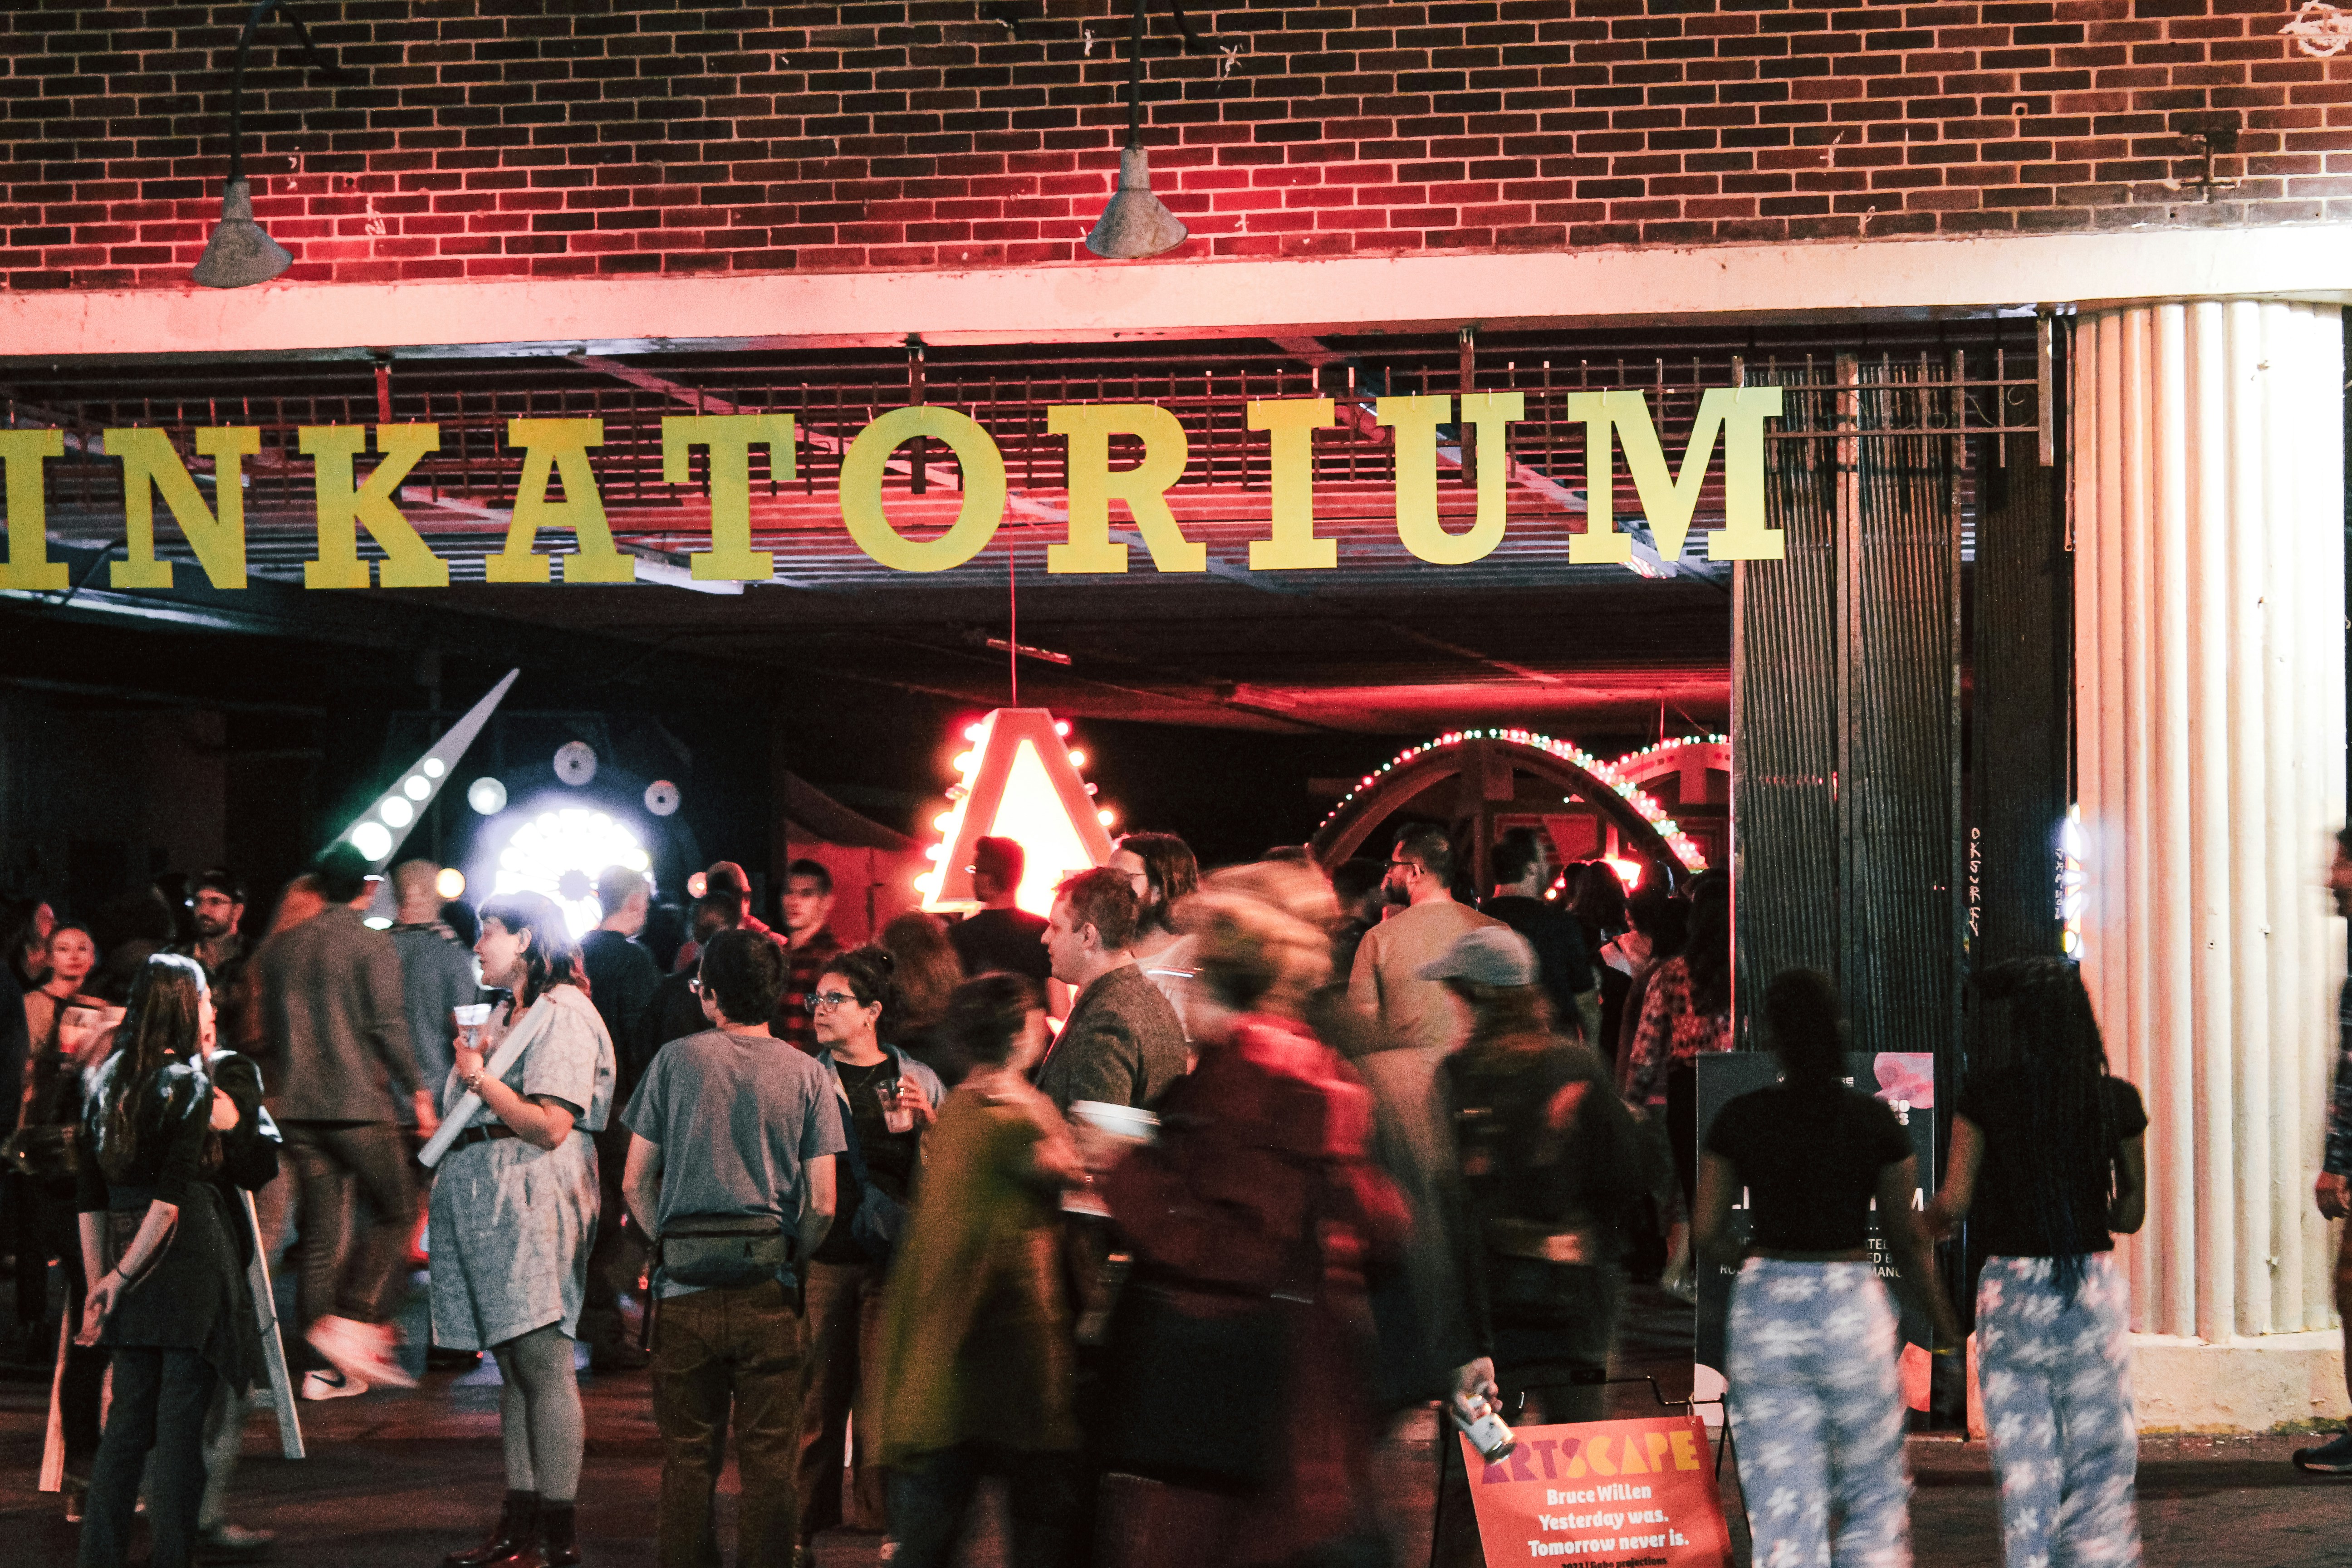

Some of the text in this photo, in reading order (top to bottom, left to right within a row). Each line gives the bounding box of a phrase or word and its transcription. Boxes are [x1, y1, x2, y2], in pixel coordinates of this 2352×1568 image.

[0, 386, 1784, 589] INKATORIUM
[1546, 1483, 1652, 1506] Bruce Willen
[1538, 1509, 1670, 1531] Yesterday was.
[1528, 1528, 1690, 1557] Tomorrow never is.
